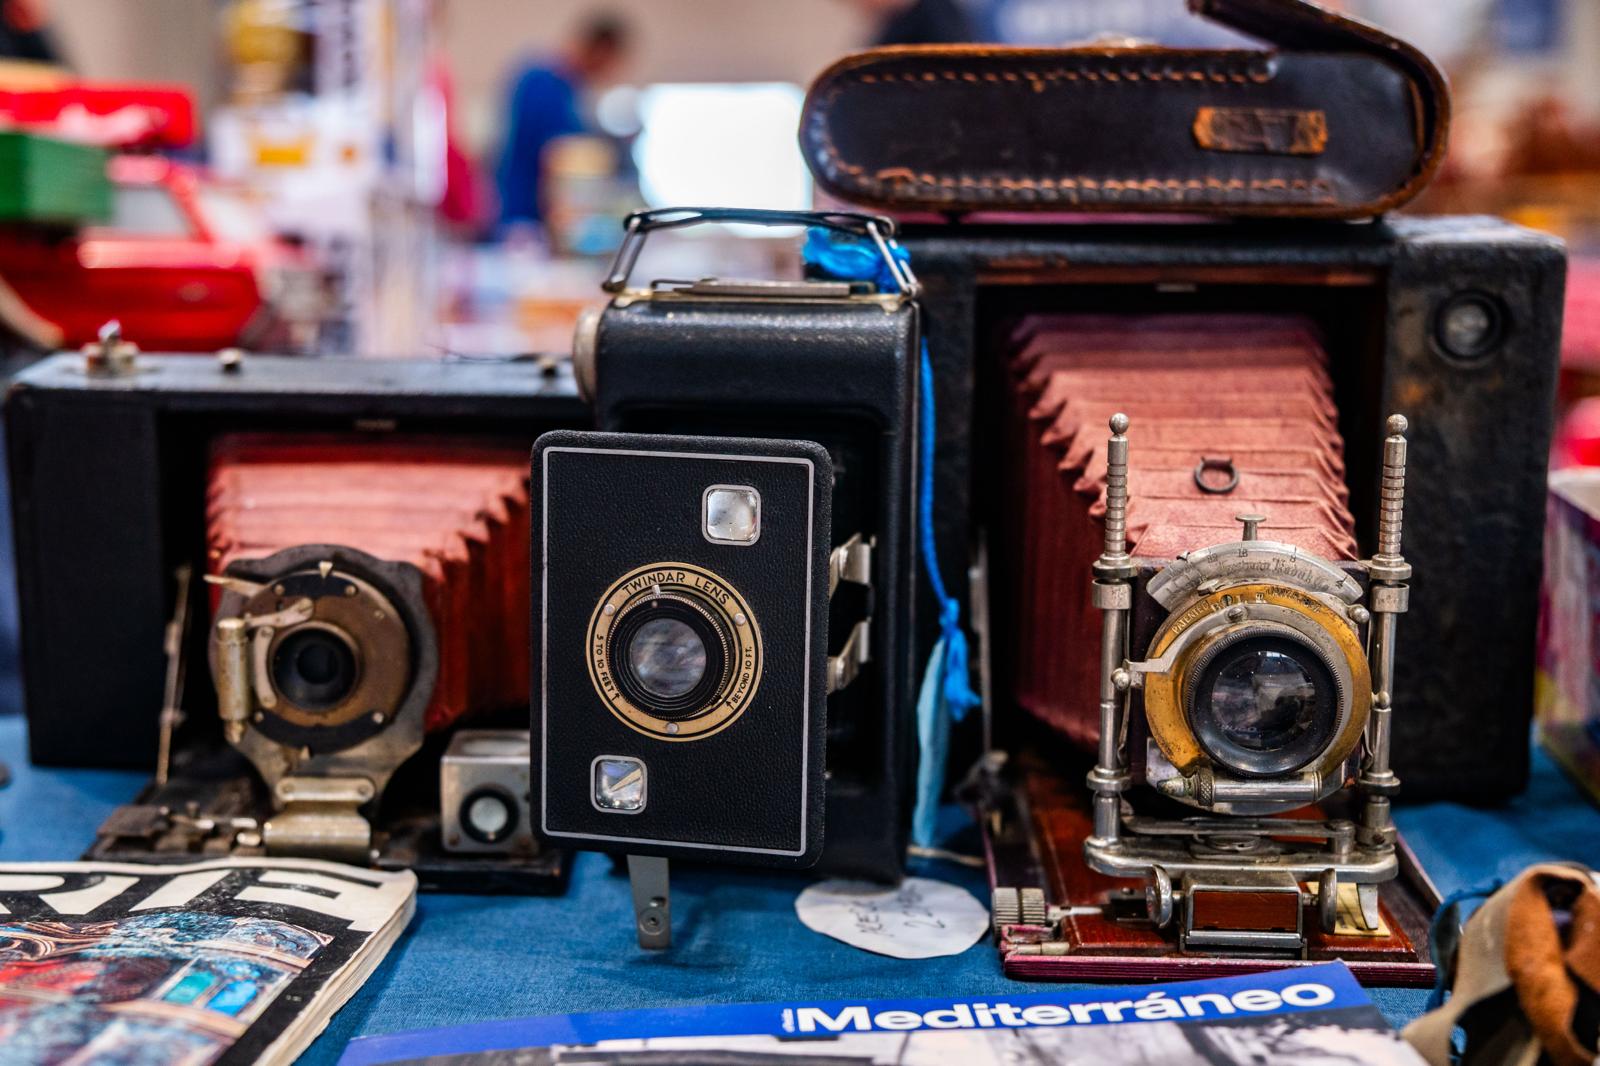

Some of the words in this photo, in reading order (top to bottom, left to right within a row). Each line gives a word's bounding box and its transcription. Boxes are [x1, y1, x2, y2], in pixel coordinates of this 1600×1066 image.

[622, 572, 685, 596] TWINDAR
[694, 577, 731, 606] LENS
[1171, 599, 1211, 634] PATENTED
[596, 644, 603, 656] TO
[596, 659, 605, 669] 10
[600, 671, 615, 692] FEET
[731, 672, 750, 704] BEYOND
[745, 660, 752, 670] 10
[796, 982, 1336, 1032] Mediterráneo
